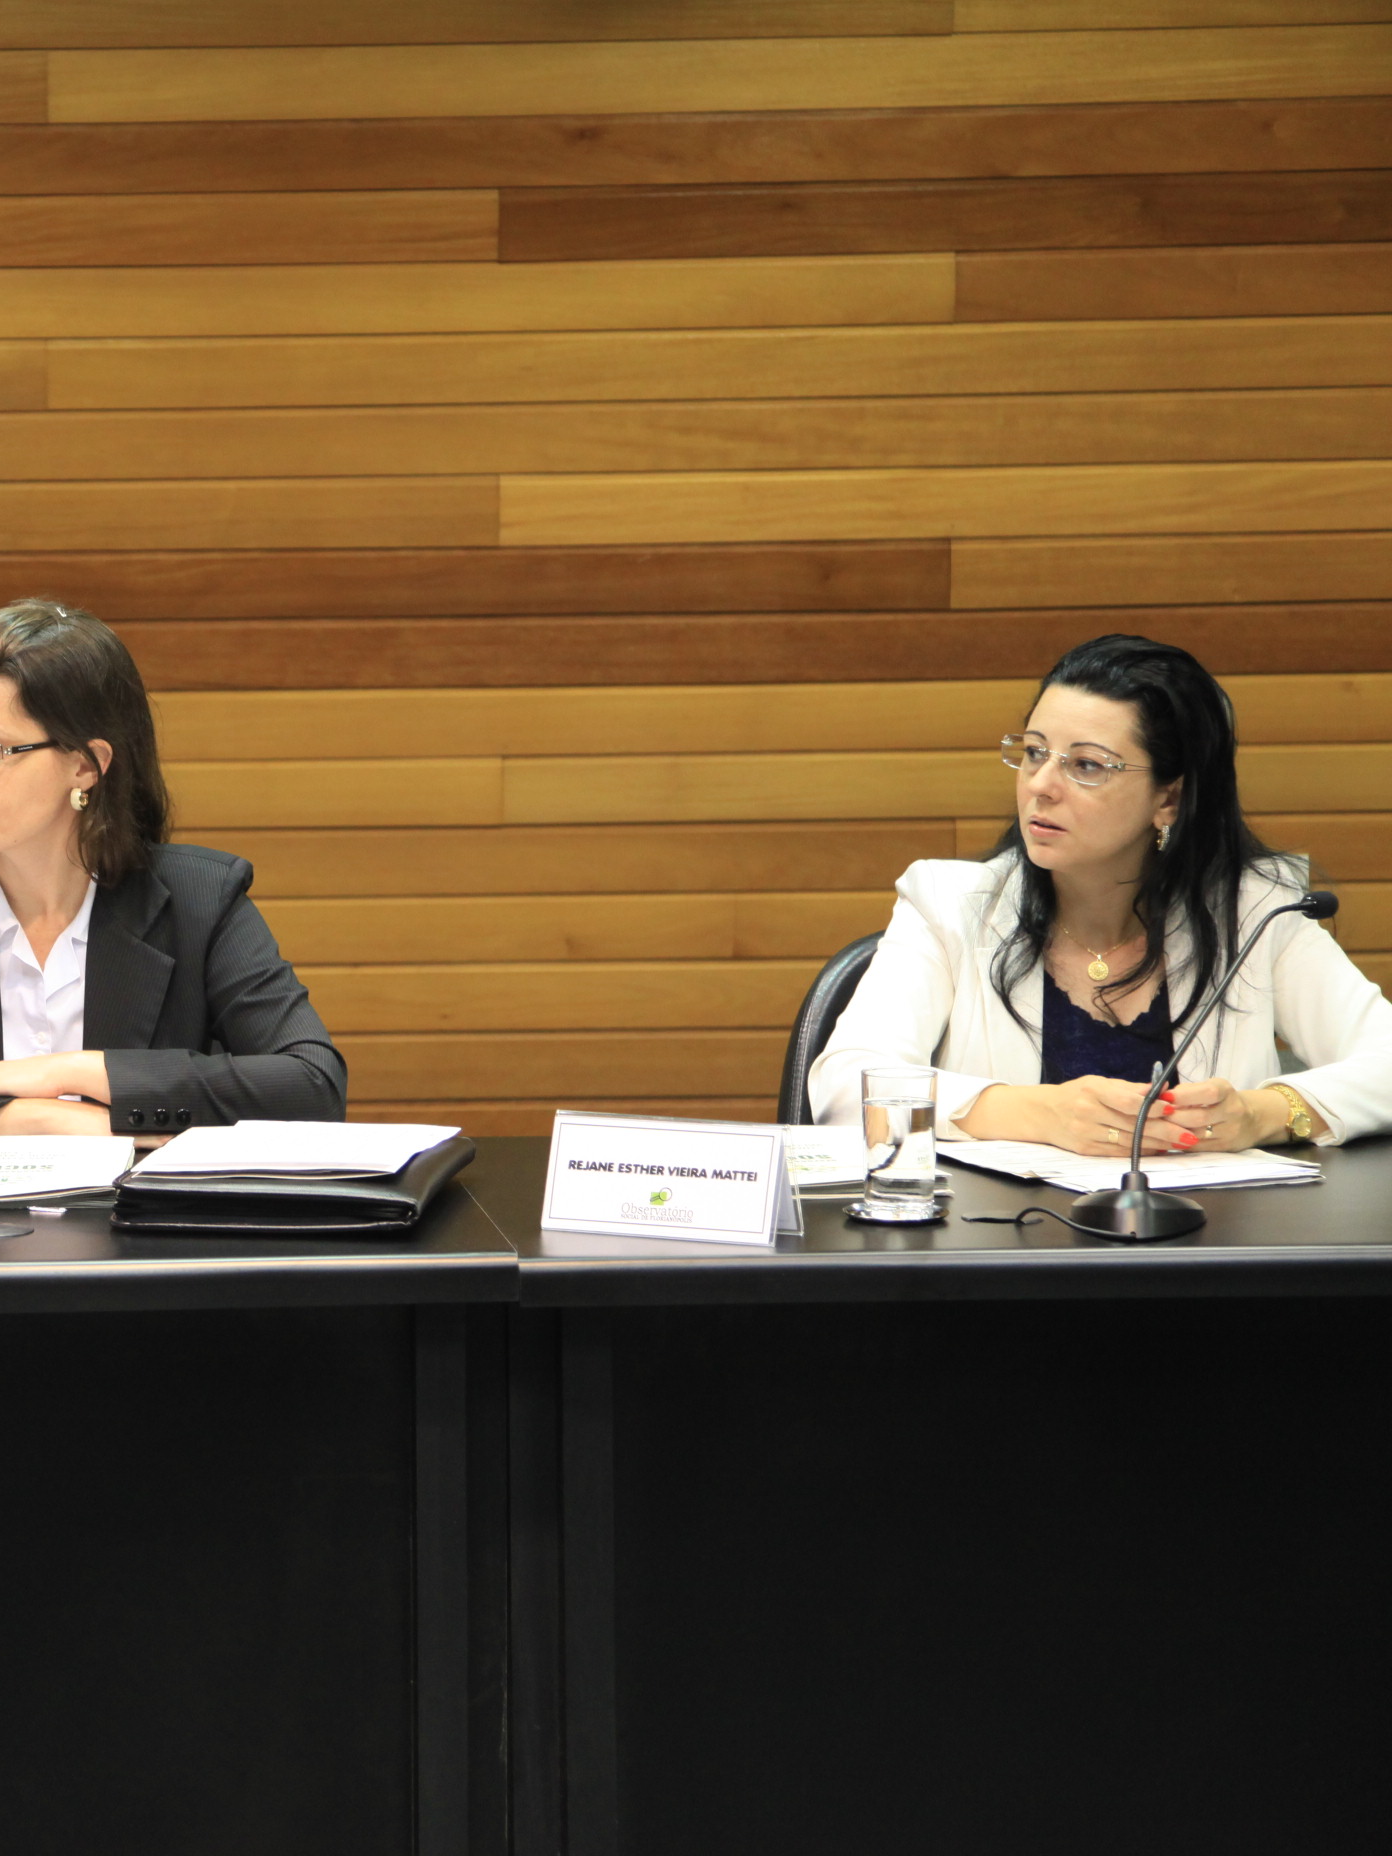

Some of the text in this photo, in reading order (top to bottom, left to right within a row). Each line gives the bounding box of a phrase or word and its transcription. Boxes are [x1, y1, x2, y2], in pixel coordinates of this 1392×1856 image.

[567, 1159, 758, 1182] REJANE ESTHER VIEIRA MATTEI
[621, 1201, 694, 1218] Observatório
